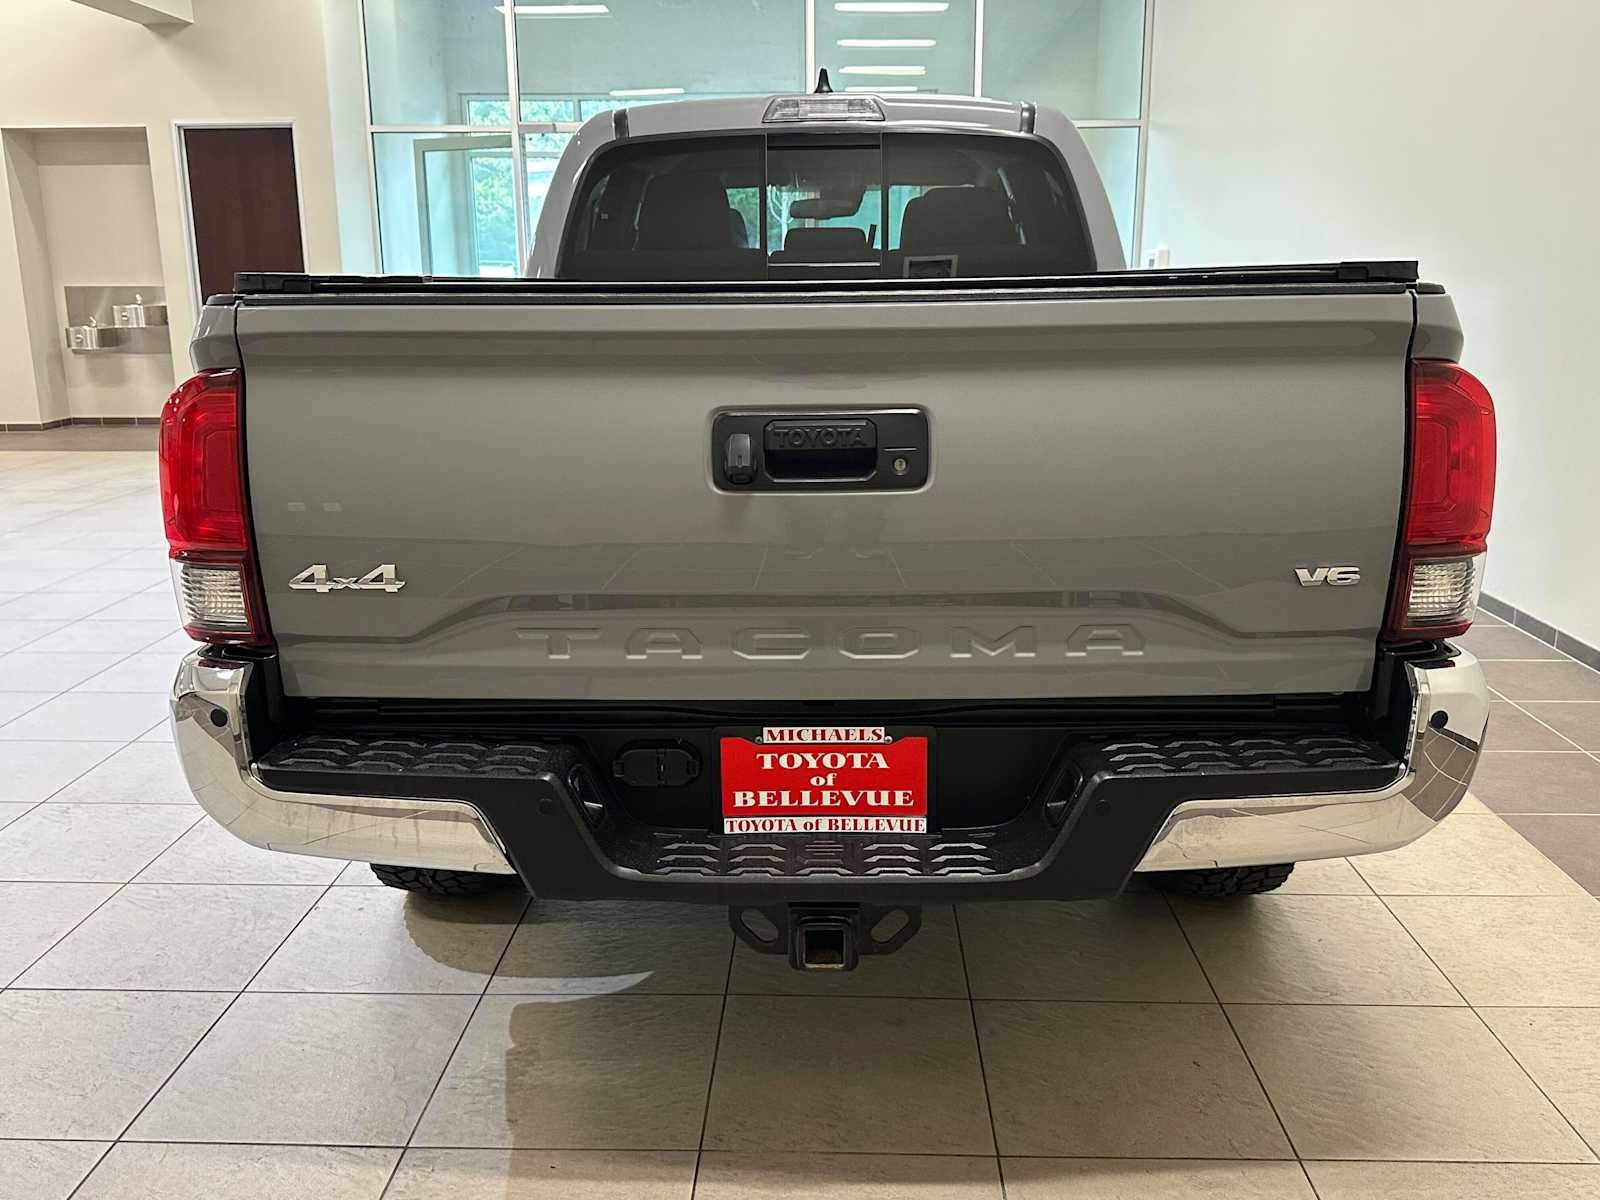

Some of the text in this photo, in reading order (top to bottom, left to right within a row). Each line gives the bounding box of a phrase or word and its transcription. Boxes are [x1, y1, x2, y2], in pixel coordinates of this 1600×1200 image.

[775, 427, 867, 448] TOYOTA
[1295, 566, 1360, 586] V6
[512, 623, 1145, 660] TACOMA
[766, 728, 883, 741] MICHAELS
[756, 752, 889, 769] TOYOTA
[809, 773, 837, 786] of
[733, 790, 914, 807] BELLEVUE
[725, 818, 925, 832] TOYOTA of BELLEVUE
